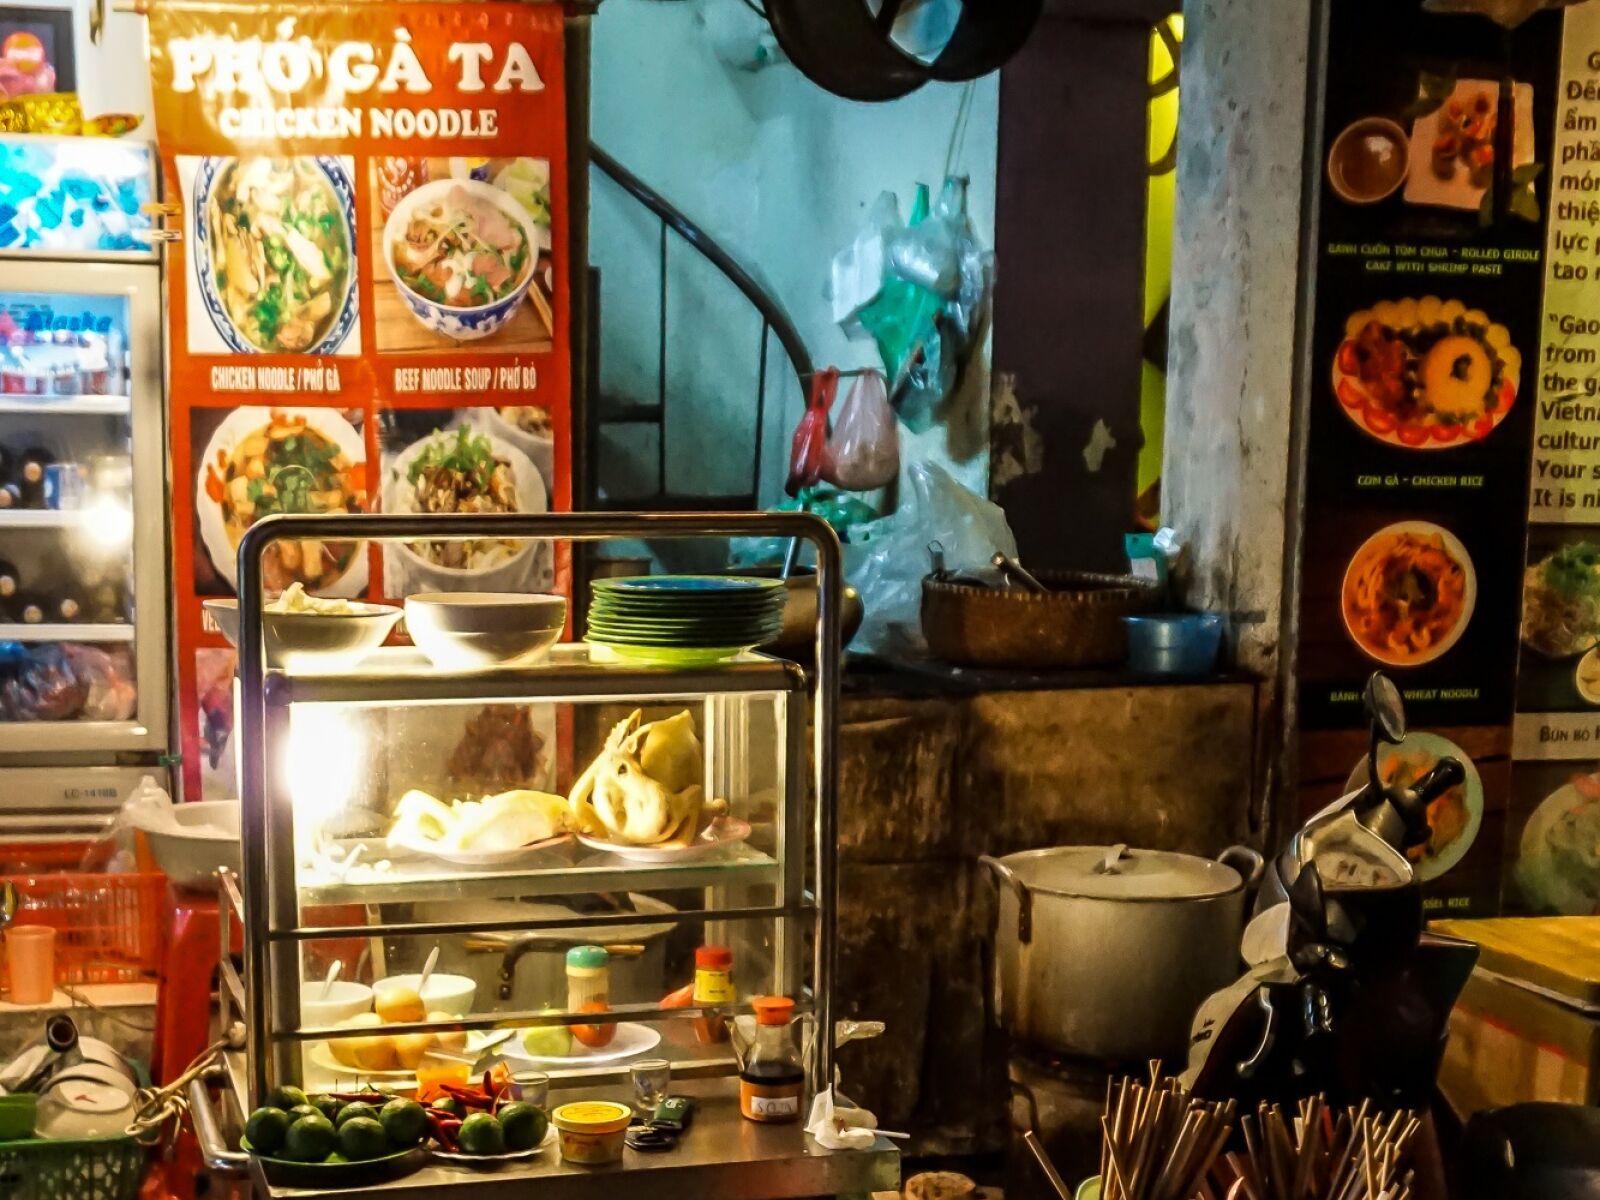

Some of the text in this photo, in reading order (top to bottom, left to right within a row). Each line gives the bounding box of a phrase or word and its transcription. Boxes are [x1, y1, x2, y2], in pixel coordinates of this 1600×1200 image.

[329, 26, 433, 93] GÀ
[448, 42, 545, 93] TA
[1567, 79, 1600, 100] Đế
[220, 108, 498, 139] CHICKEN NOODLE
[1461, 247, 1500, 260] ROLLED
[1503, 250, 1540, 261] GIRDLE
[1556, 230, 1590, 257] lực
[1396, 262, 1424, 272] WITH
[1428, 263, 1468, 274] SHRIMP
[1472, 263, 1503, 275] PASTE
[1546, 342, 1596, 363] from
[212, 366, 256, 391] CHICKEN
[257, 366, 296, 391] NOODLE
[326, 363, 341, 391] GÀ
[395, 367, 420, 391] BEEF
[422, 367, 462, 390] NOODLE
[464, 367, 491, 390] SOUP
[1543, 371, 1577, 392] the
[1541, 400, 1600, 421] Vietn
[1536, 459, 1587, 479] Your
[1412, 475, 1457, 486] CHICKEN
[1460, 475, 1484, 486] RICE
[1533, 488, 1551, 508] It
[1559, 488, 1576, 508] is
[1404, 688, 1480, 701] WHEAT NOODLE
